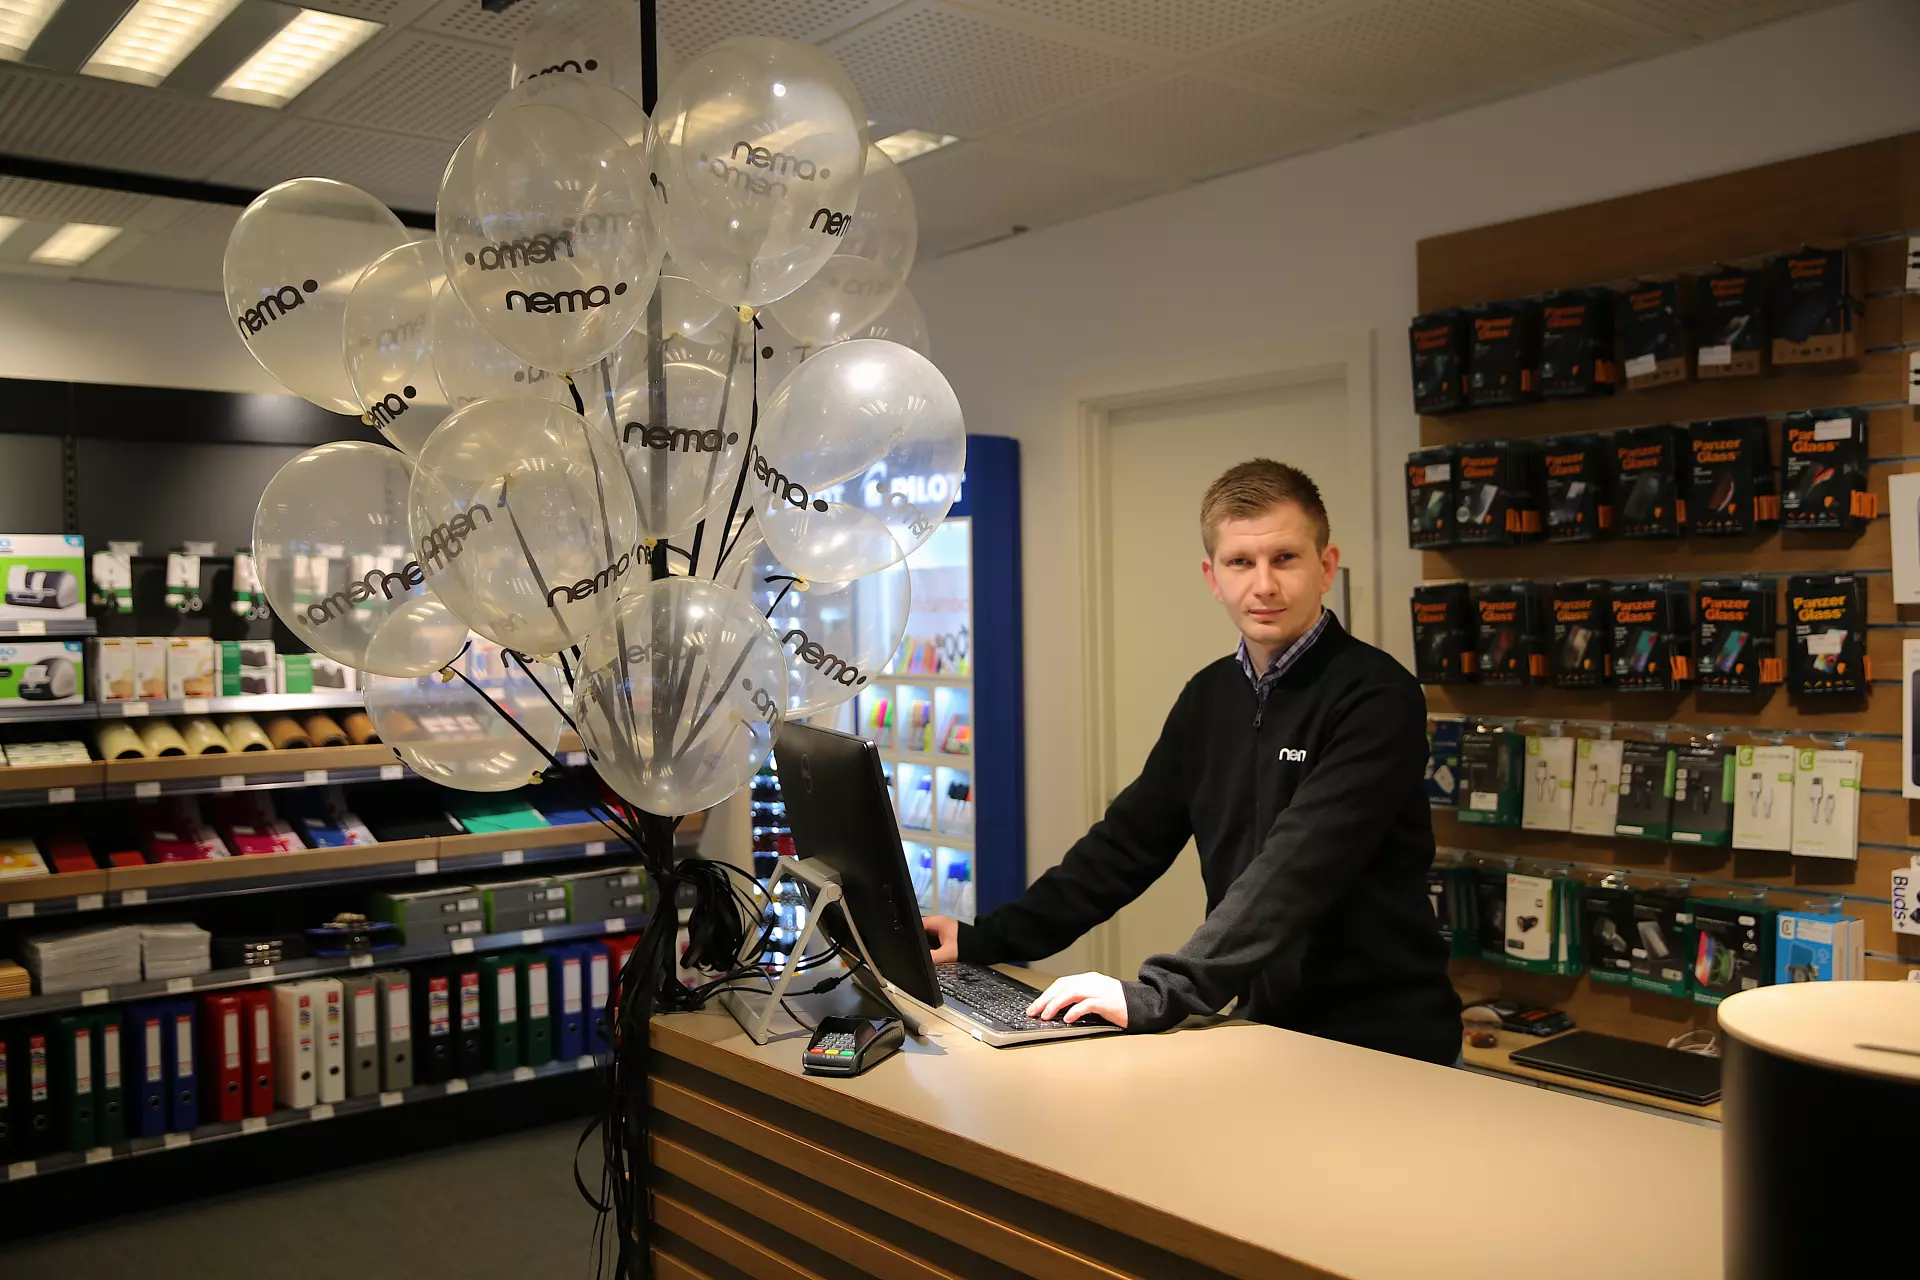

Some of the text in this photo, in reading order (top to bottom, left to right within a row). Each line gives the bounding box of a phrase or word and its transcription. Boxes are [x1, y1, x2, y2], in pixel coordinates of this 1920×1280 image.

[809, 208, 851, 237] nem
[237, 285, 305, 340] nema
[505, 285, 611, 313] nema
[367, 392, 409, 430] ema
[623, 421, 727, 453] nema
[1789, 429, 1816, 440] Pan
[890, 472, 967, 506] PILOT
[547, 552, 633, 608] nema
[1702, 597, 1750, 609] Panzer
[1794, 595, 1847, 609] Panzer
[1798, 608, 1846, 622] Glass
[782, 629, 859, 687] nema
[1893, 875, 1909, 928] Buds+
